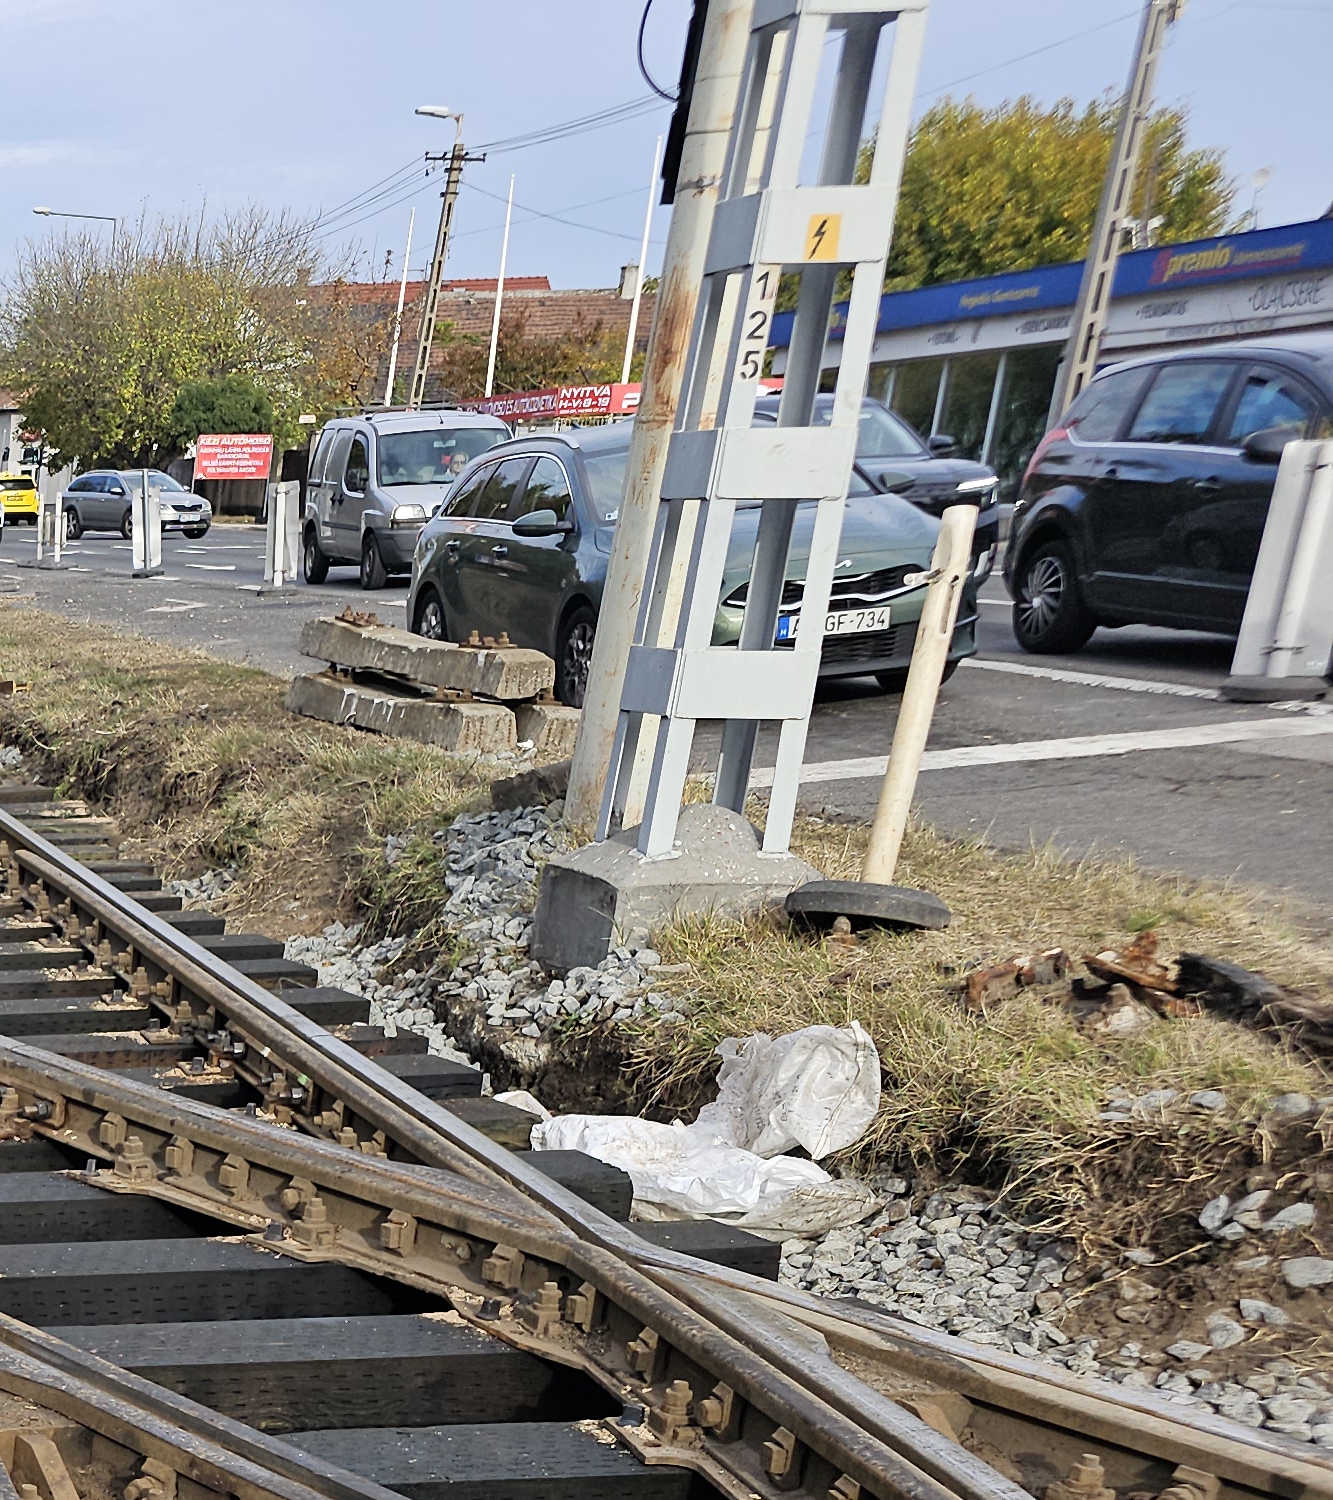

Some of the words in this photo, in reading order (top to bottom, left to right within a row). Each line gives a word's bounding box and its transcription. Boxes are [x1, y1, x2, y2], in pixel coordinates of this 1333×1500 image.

[1162, 242, 1233, 283] premio
[740, 271, 770, 379] 125
[560, 386, 611, 399] NYITVA
[825, 610, 886, 632] GF-734
